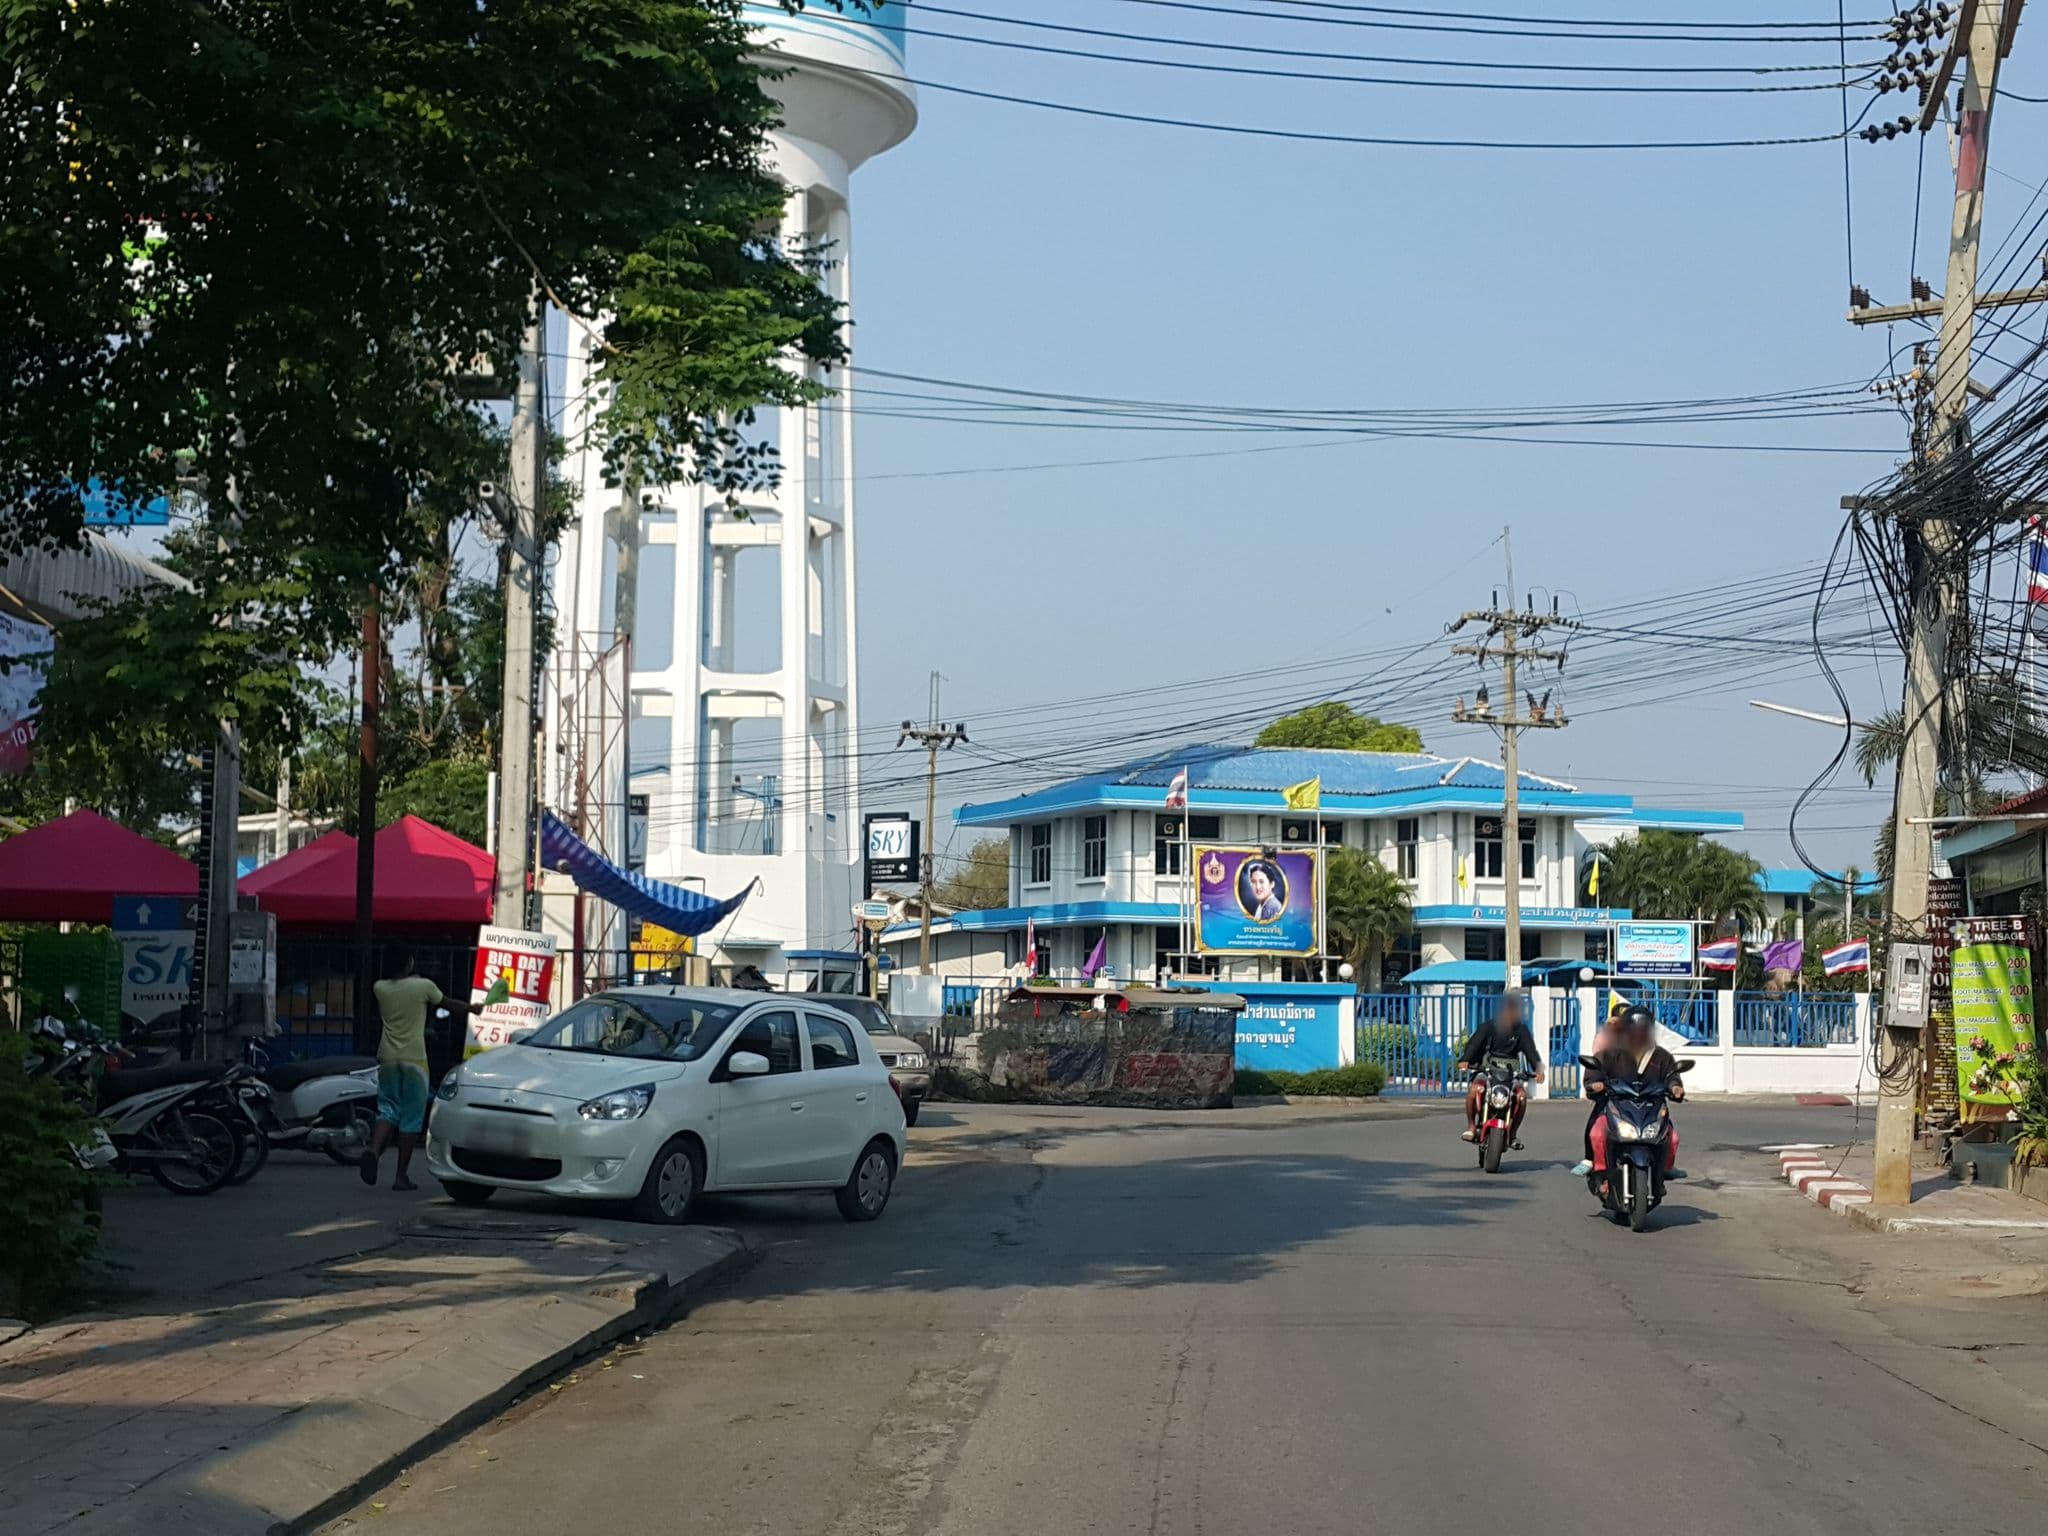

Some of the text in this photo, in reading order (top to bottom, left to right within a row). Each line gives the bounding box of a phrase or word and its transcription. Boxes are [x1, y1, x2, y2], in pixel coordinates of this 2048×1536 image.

[871, 829, 909, 855] SKY
[1973, 920, 2022, 932] TREE-B
[1974, 932, 2026, 942] MASSAGE
[127, 940, 194, 986] SK
[488, 950, 546, 972] BIG DAY
[2007, 957, 2028, 969] 200
[483, 965, 541, 996] SALE
[2009, 984, 2030, 996] 200
[2011, 1013, 2032, 1025] 300
[474, 1025, 501, 1043] 7.5
